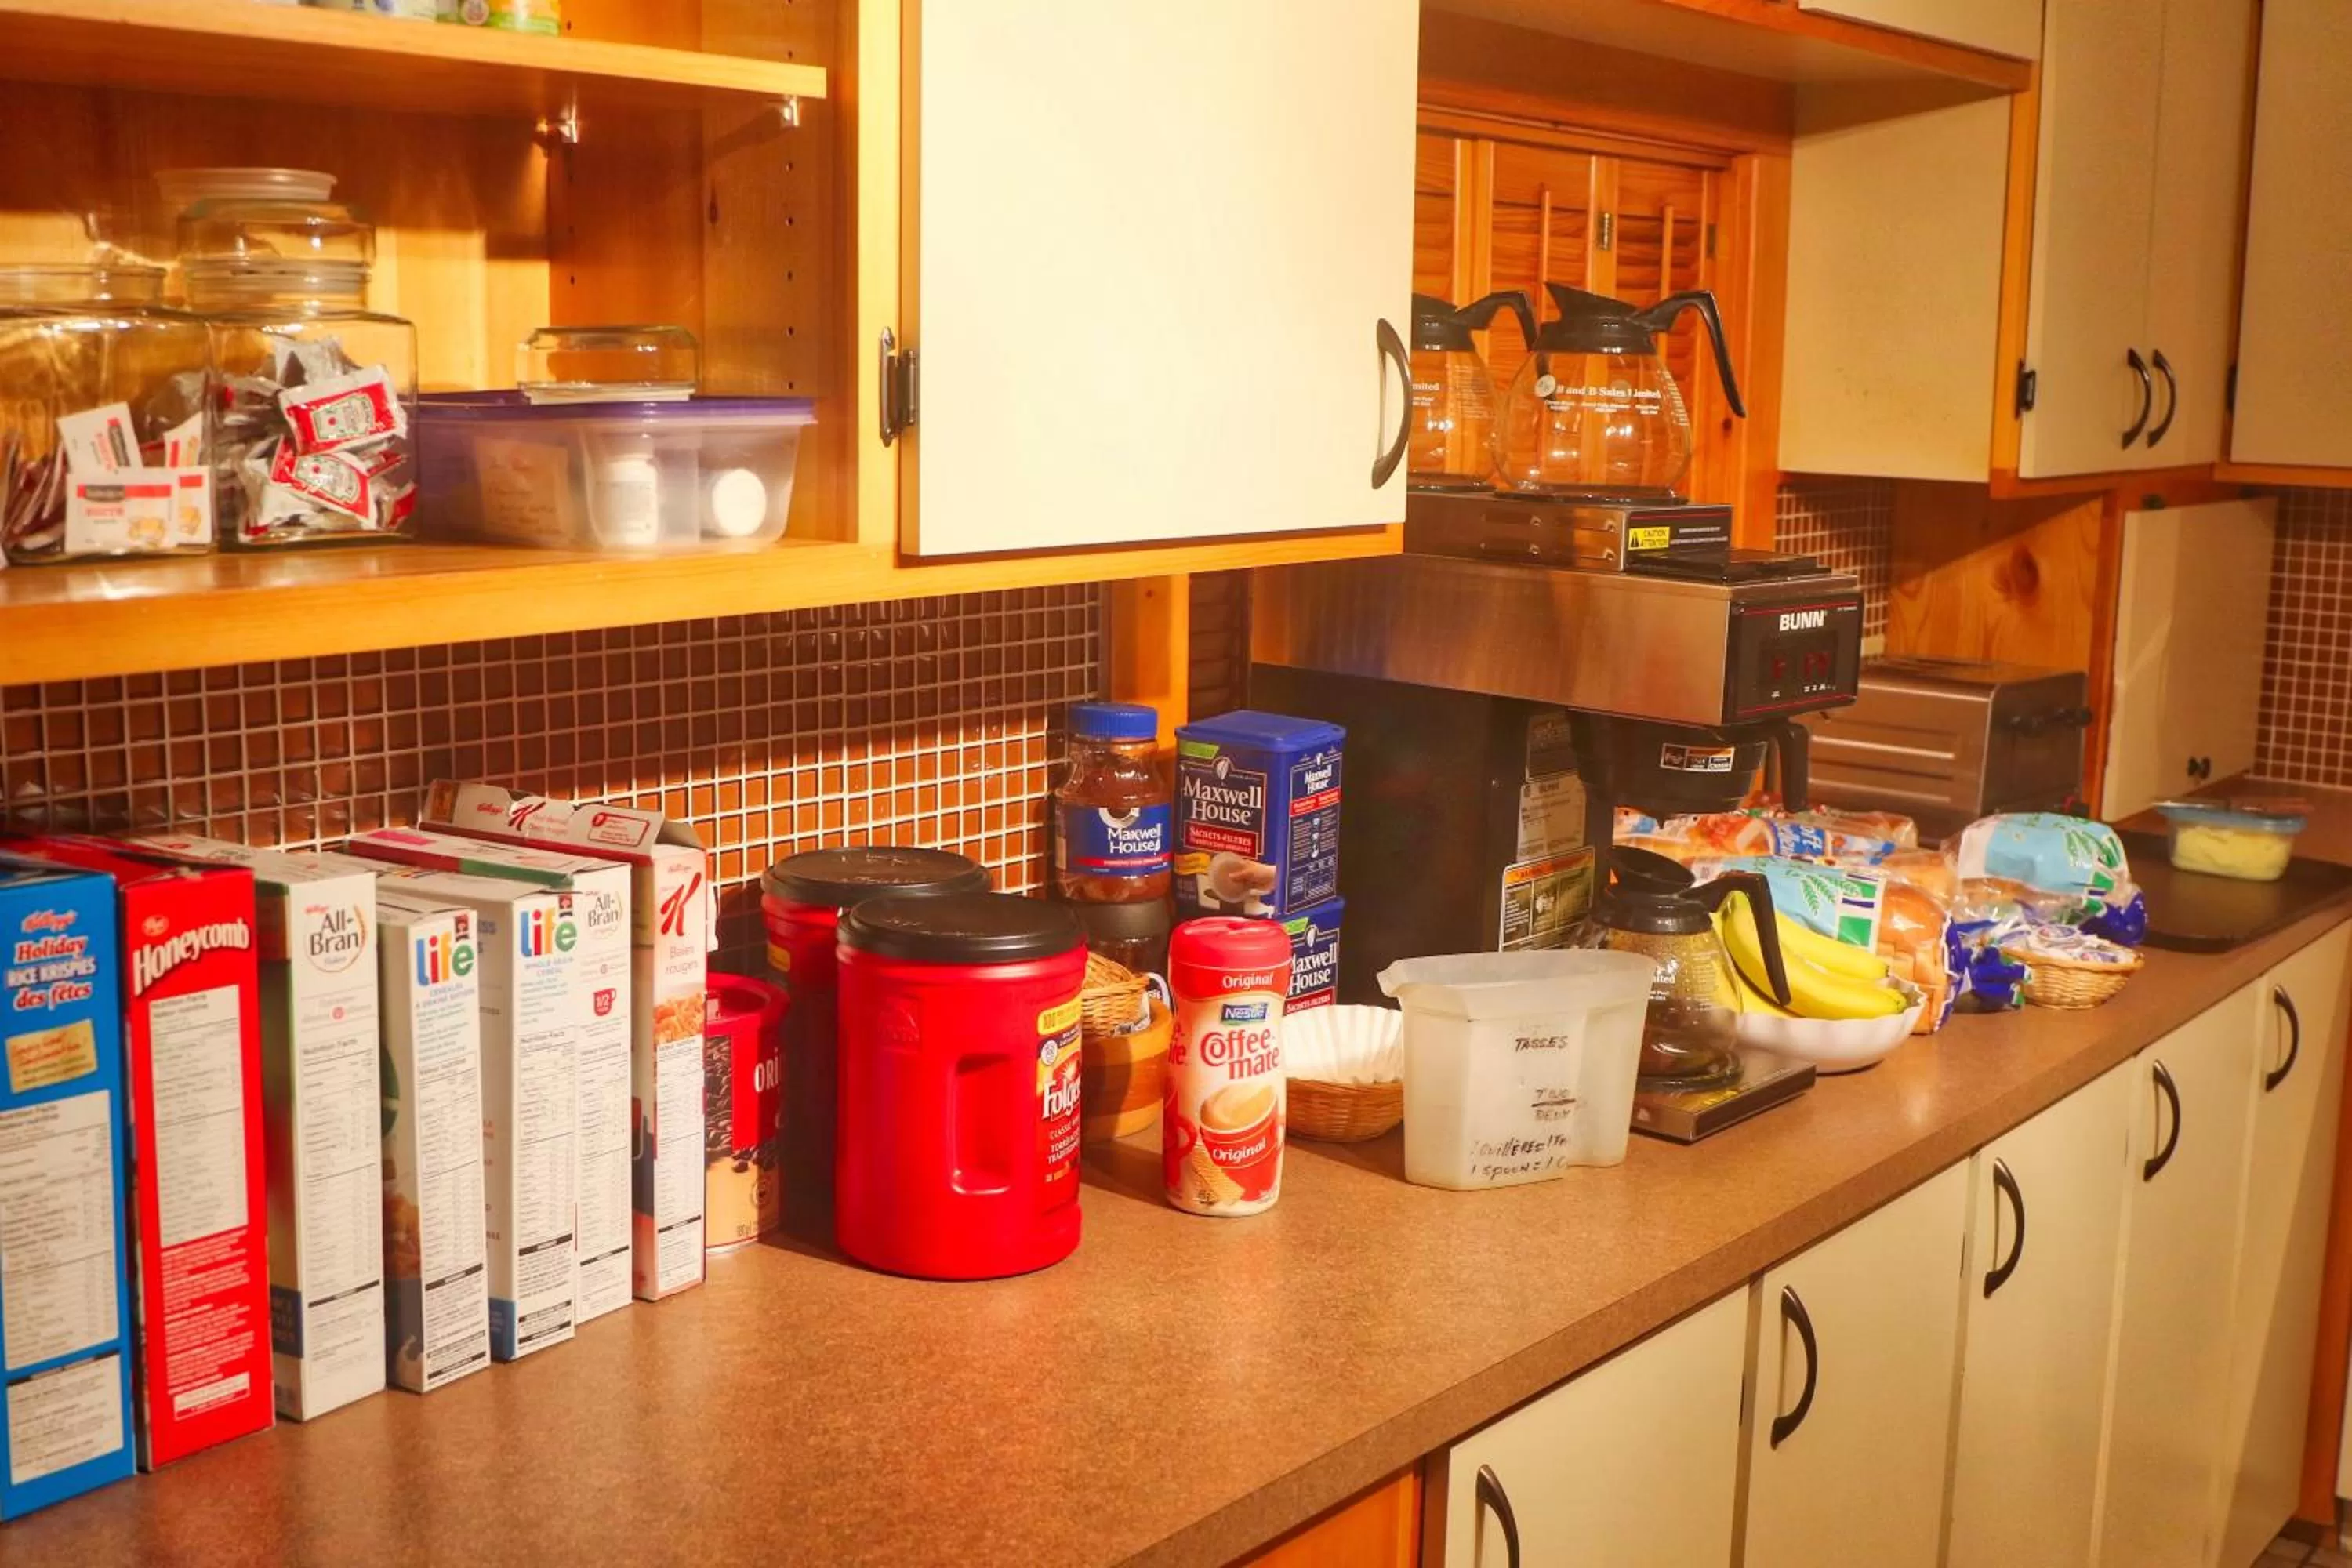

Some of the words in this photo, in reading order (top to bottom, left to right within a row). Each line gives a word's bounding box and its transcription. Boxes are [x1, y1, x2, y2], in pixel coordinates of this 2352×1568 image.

[1779, 610, 1826, 632] BUNN
[1183, 775, 1262, 809] Maxwell
[1190, 799, 1252, 826] House
[1109, 838, 1156, 854] House
[660, 872, 702, 936] K
[587, 909, 619, 927] Bran
[14, 935, 88, 964] Holiday
[132, 916, 250, 997] Honeycomb
[310, 932, 359, 956] Bran
[1221, 971, 1274, 991] Original
[1289, 967, 1330, 996] House
[13, 987, 48, 1011] des
[1200, 1027, 1272, 1067] Coffee
[1515, 1035, 1569, 1052] TASSES
[1228, 1046, 1280, 1080] mate
[1042, 1074, 1080, 1118] Folge
[1212, 1137, 1267, 1164] Original
